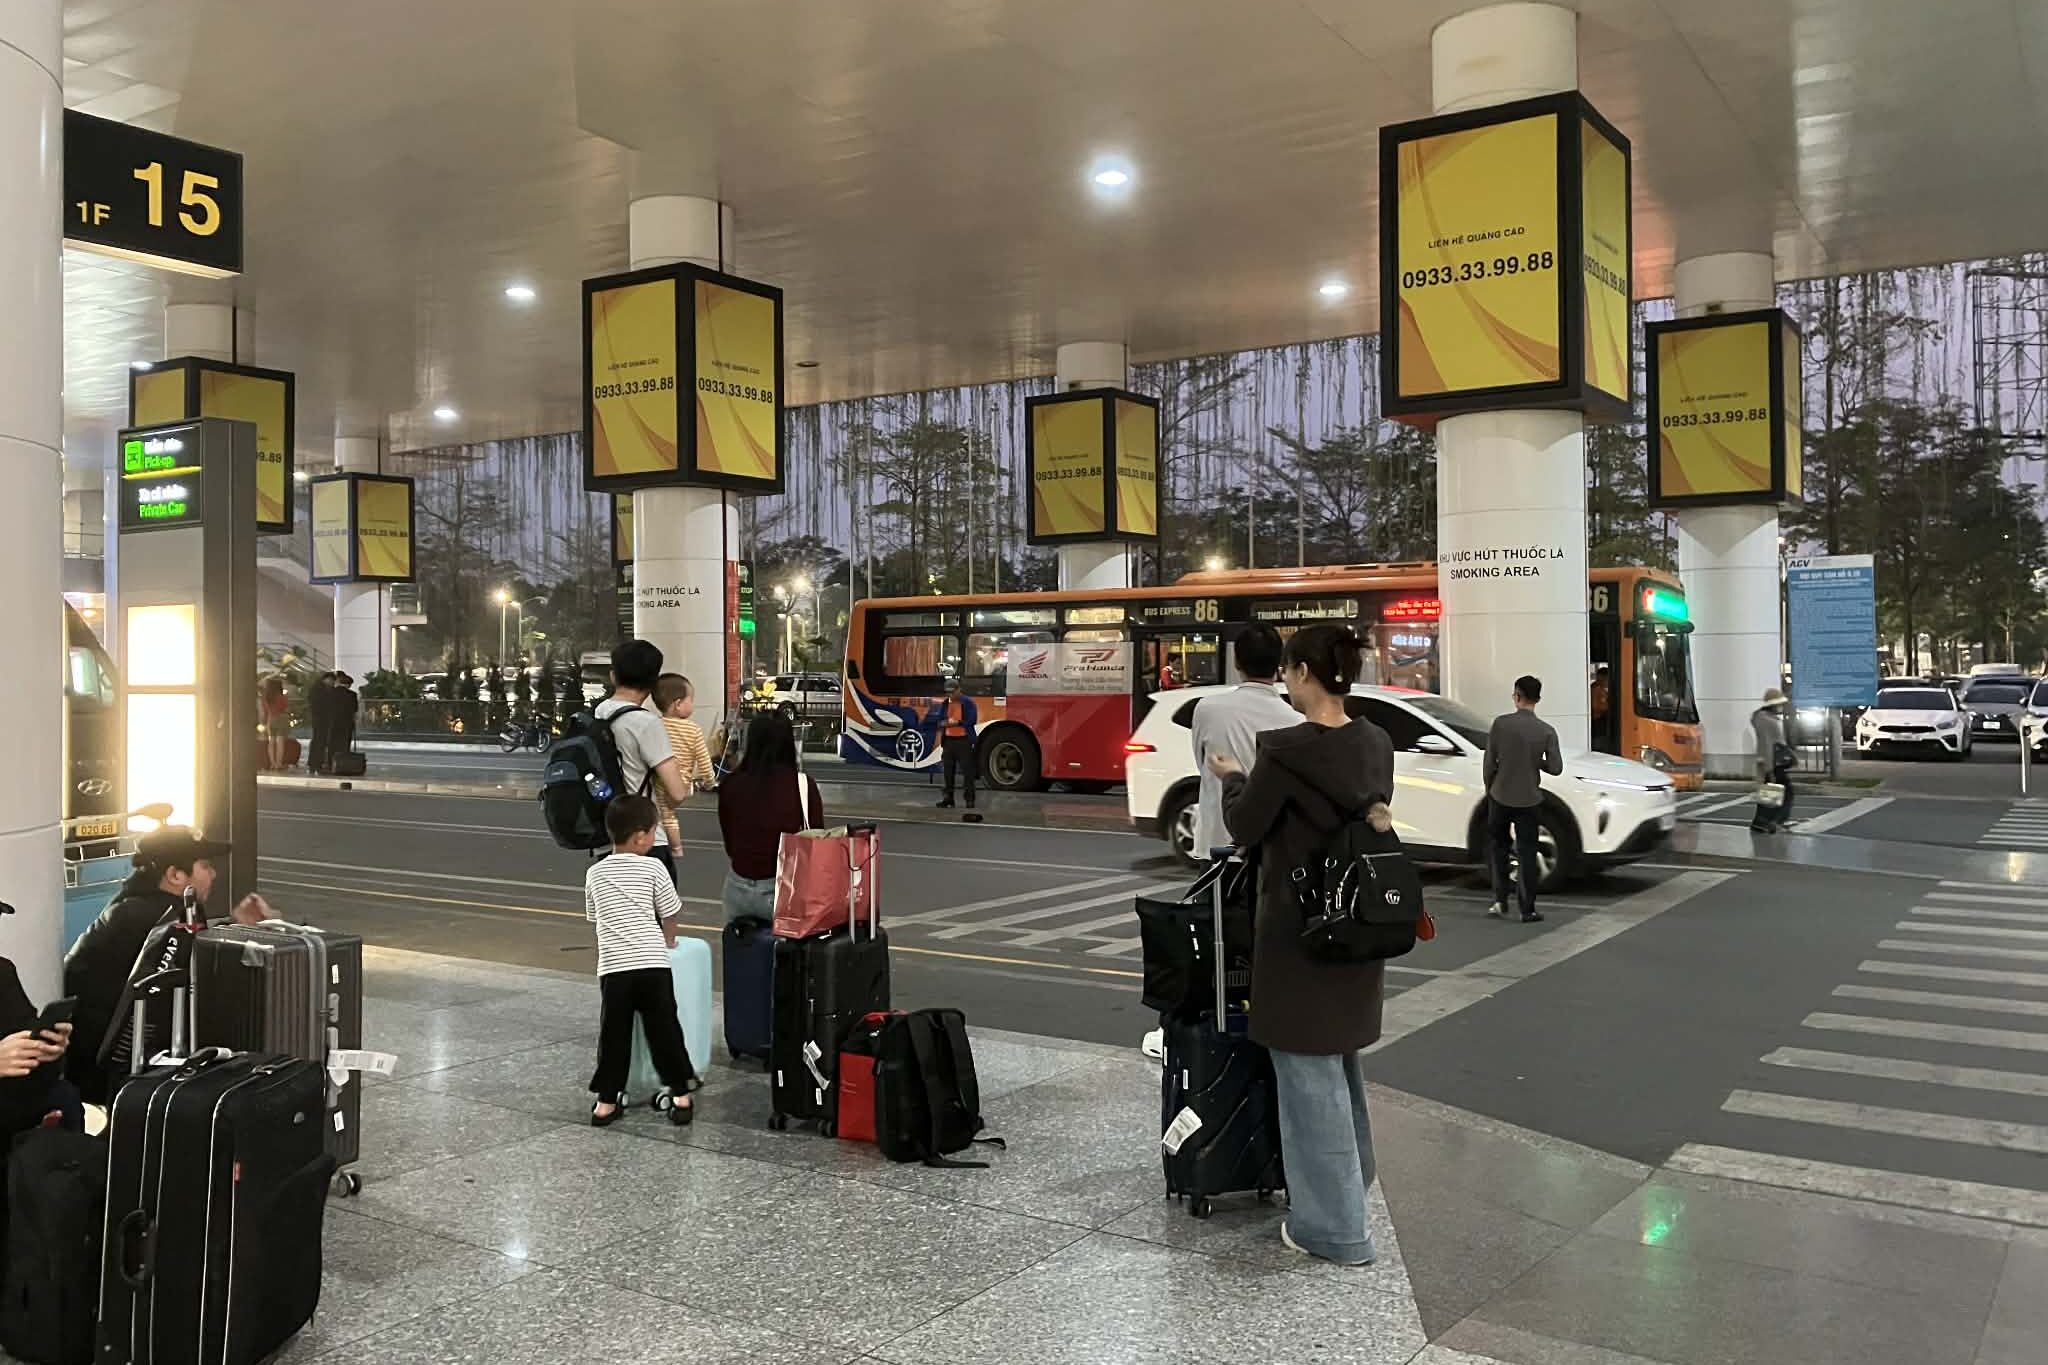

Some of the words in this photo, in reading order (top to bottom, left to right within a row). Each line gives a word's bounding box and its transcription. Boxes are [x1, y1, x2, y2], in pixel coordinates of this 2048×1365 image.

[76, 201, 112, 225] 1F
[133, 161, 221, 236] 15
[1403, 251, 1554, 289] 0933.33.99.88
[594, 376, 674, 400] 0933.33.99.88
[698, 377, 773, 404] 0933.33.99.88
[1663, 408, 1767, 428] 0933.33.99.88
[1474, 548, 1499, 560] HÚT
[1502, 545, 1546, 559] THUỐC
[1450, 567, 1500, 580] SMOKING
[1504, 566, 1540, 577] AREA
[1789, 559, 1810, 568] ACV
[656, 599, 681, 608] AREA
[1144, 607, 1158, 616] BUS
[1159, 606, 1191, 616] EXPRESS
[1194, 599, 1218, 621] 86
